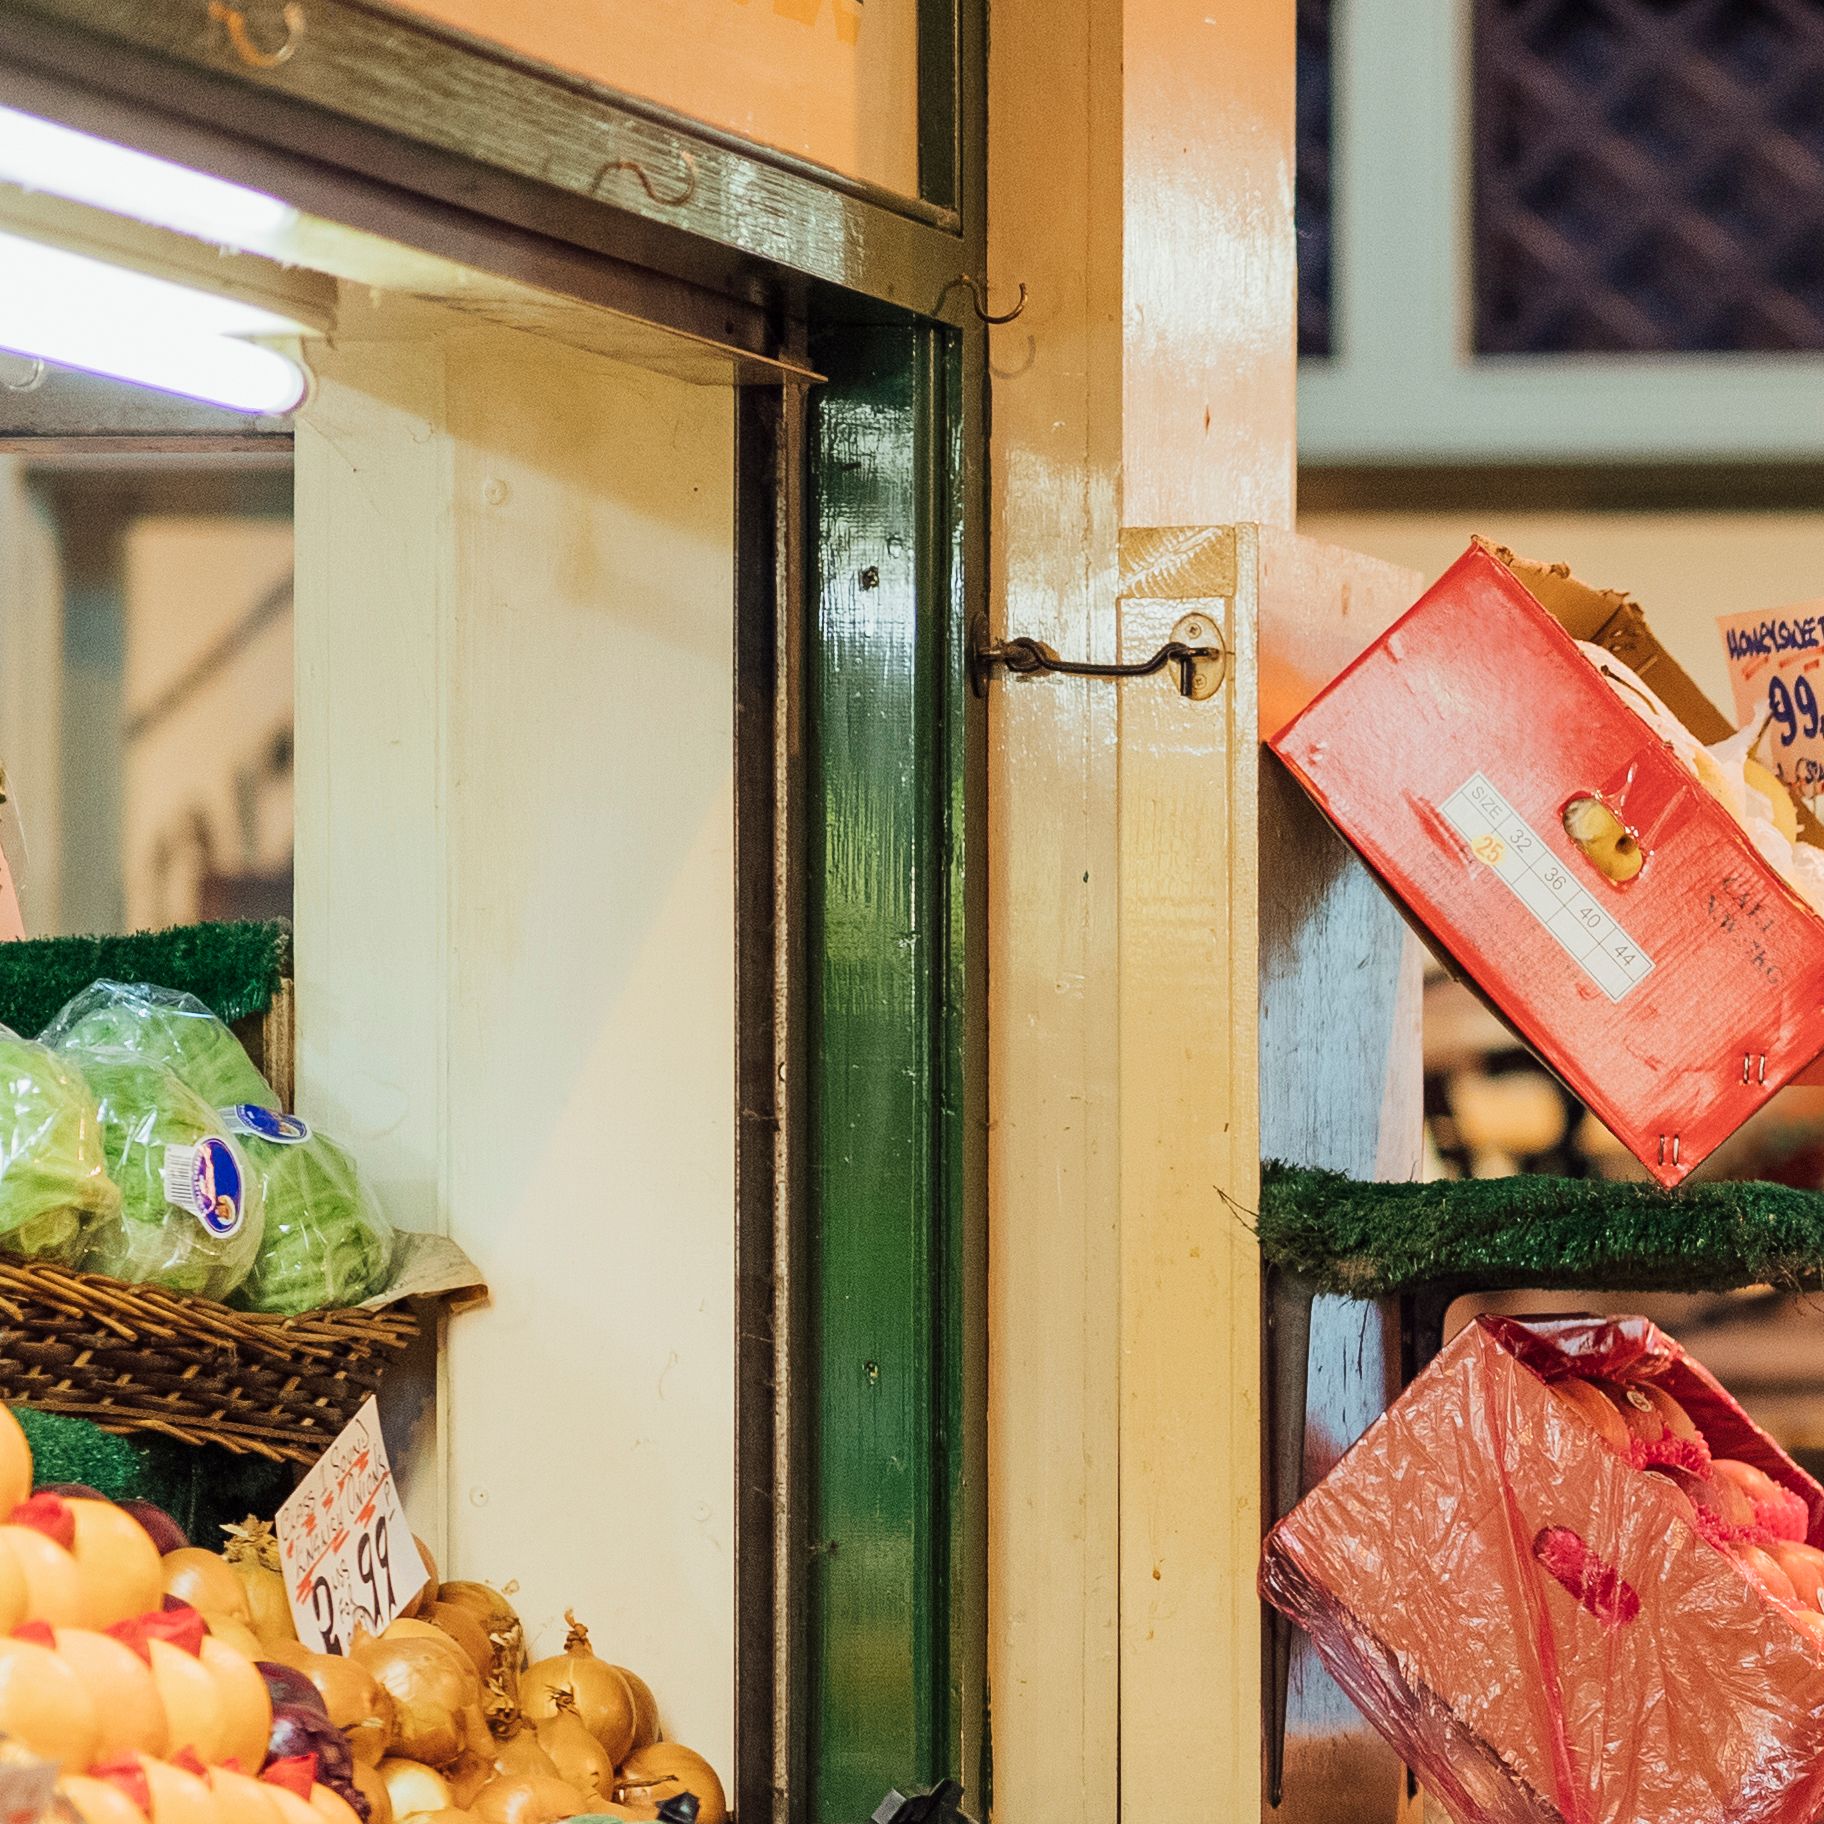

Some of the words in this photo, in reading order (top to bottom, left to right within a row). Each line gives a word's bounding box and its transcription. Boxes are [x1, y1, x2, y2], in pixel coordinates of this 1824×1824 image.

[1471, 785, 1503, 821] SIZE
[1509, 829, 1532, 854] 32
[1544, 867, 1567, 891] 36
[1580, 906, 1601, 928] 40
[1614, 945, 1636, 966] 44
[1475, 835, 1504, 865] 25
